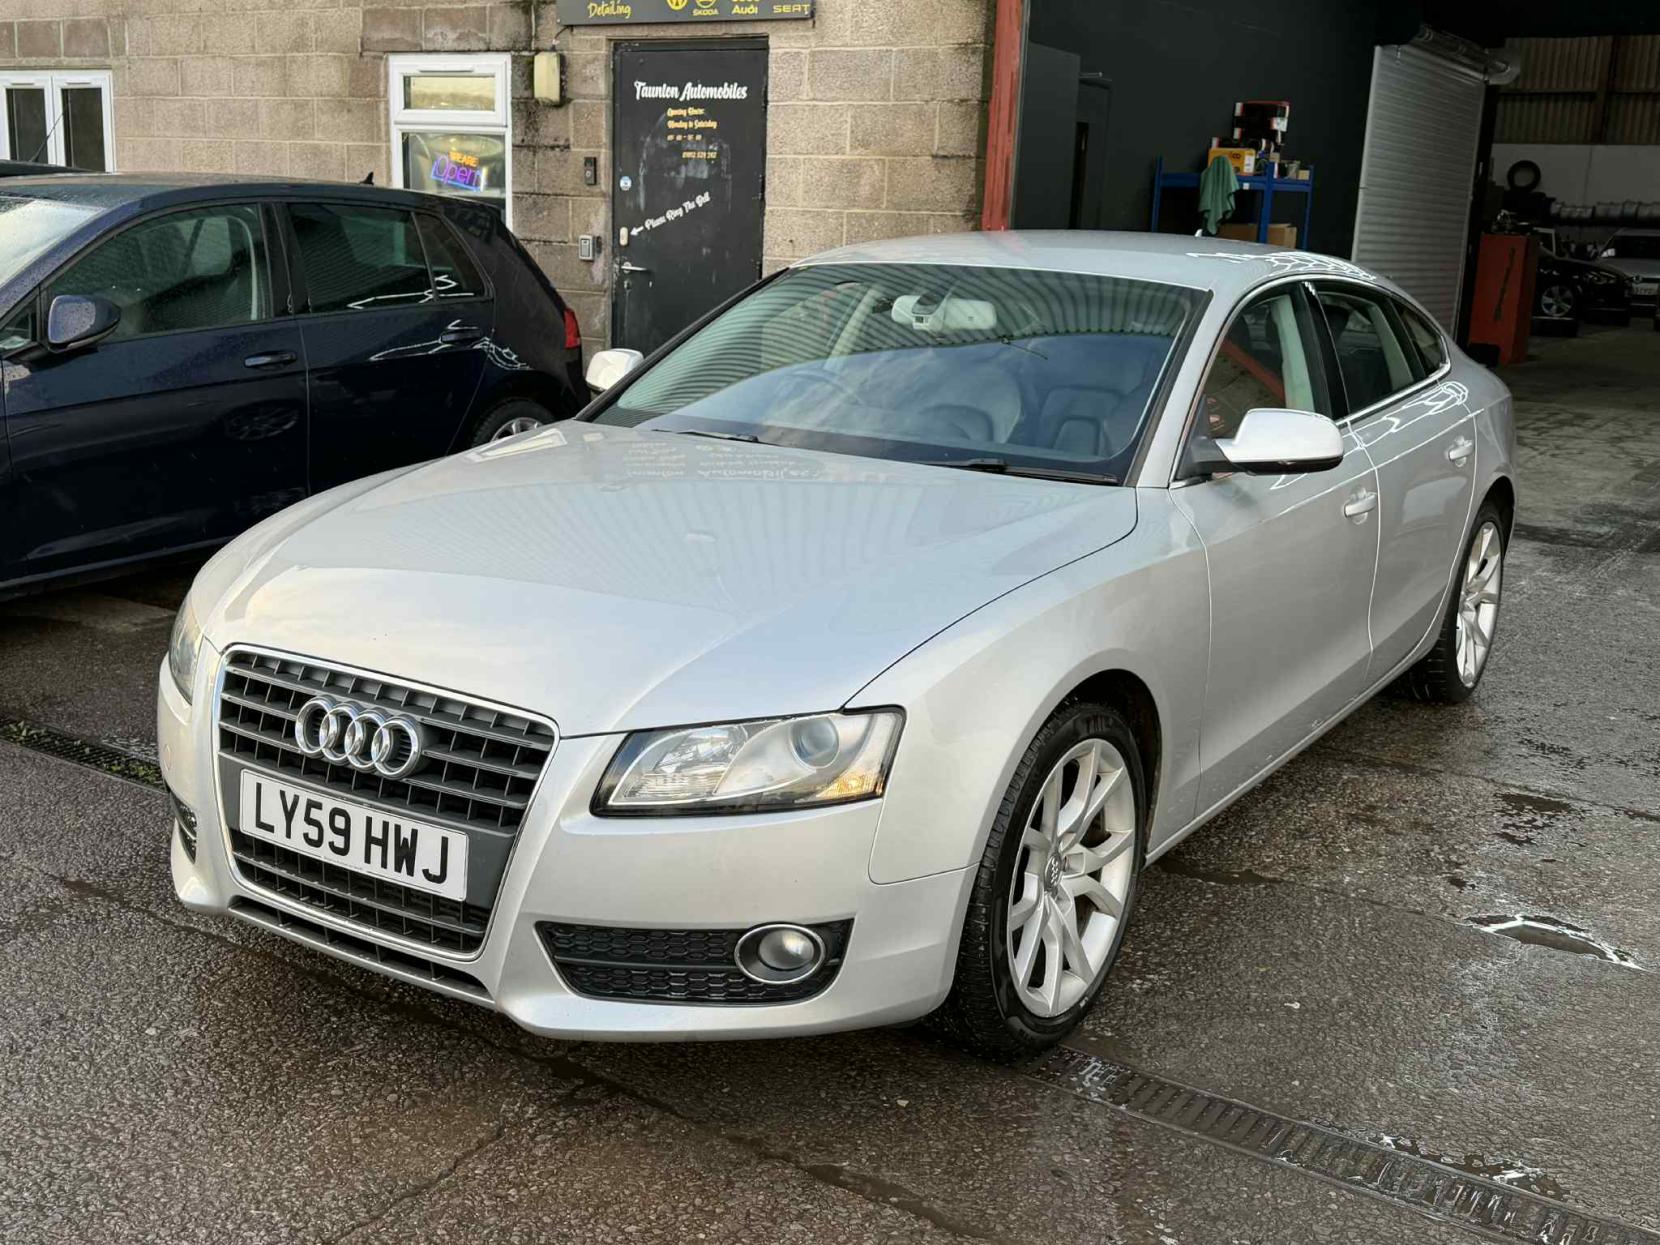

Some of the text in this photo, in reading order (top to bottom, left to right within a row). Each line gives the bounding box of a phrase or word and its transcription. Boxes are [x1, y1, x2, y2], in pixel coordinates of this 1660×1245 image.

[731, 4, 758, 15] Audi
[772, 3, 811, 14] SEAT
[634, 81, 748, 101] Taunton Automobiles
[254, 781, 449, 885] LY59 HWJ
